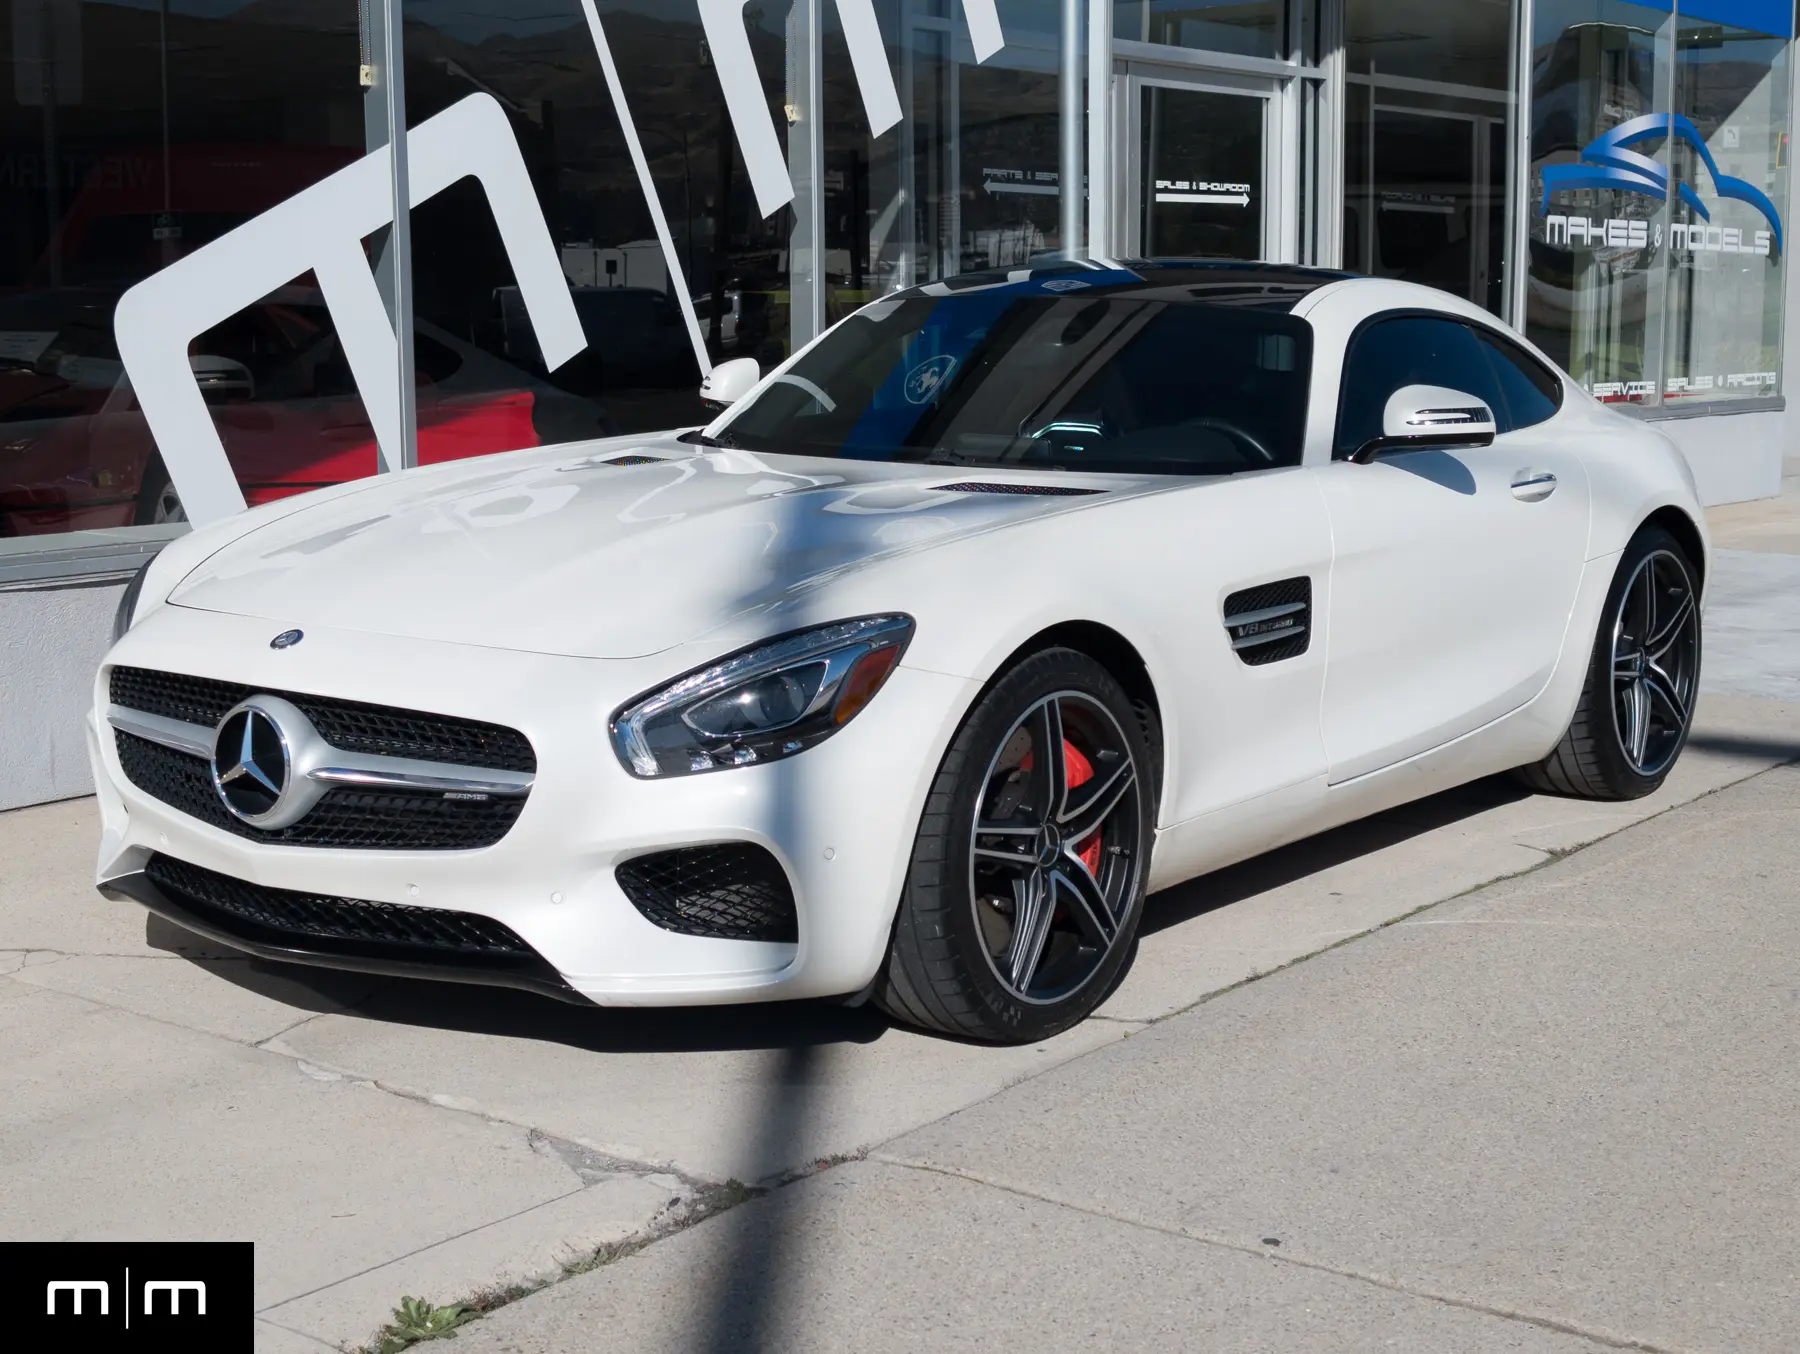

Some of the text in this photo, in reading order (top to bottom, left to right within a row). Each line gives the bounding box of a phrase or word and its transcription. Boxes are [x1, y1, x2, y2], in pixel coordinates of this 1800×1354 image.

[983, 168, 1023, 179] PARTS
[1156, 180, 1190, 190] SALES
[1199, 182, 1251, 192] SHOWROOM
[1546, 215, 1770, 255] MAKES & MODELS
[1594, 372, 1776, 397] SERVICE SALES RACING
[1238, 622, 1258, 637] V8
